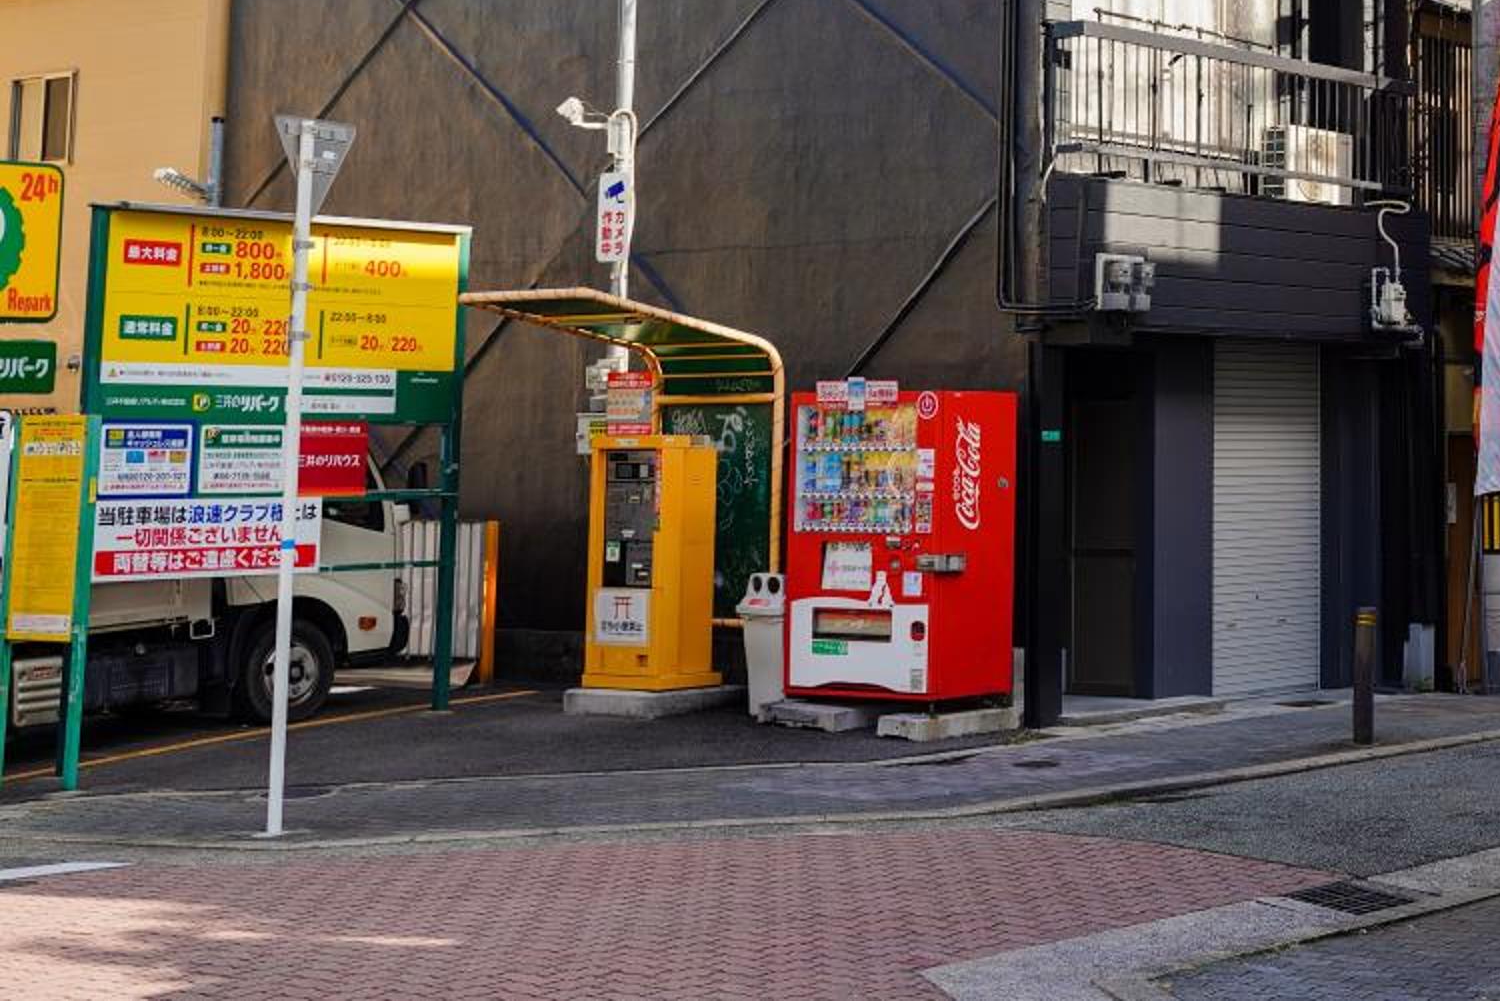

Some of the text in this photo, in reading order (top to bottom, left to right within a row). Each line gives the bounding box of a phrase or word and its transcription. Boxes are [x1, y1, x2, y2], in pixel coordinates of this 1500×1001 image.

[97, 503, 317, 526] 当駐車場は浪速クラブ様は
[113, 549, 299, 574] 両替等はご遠慮くださ
